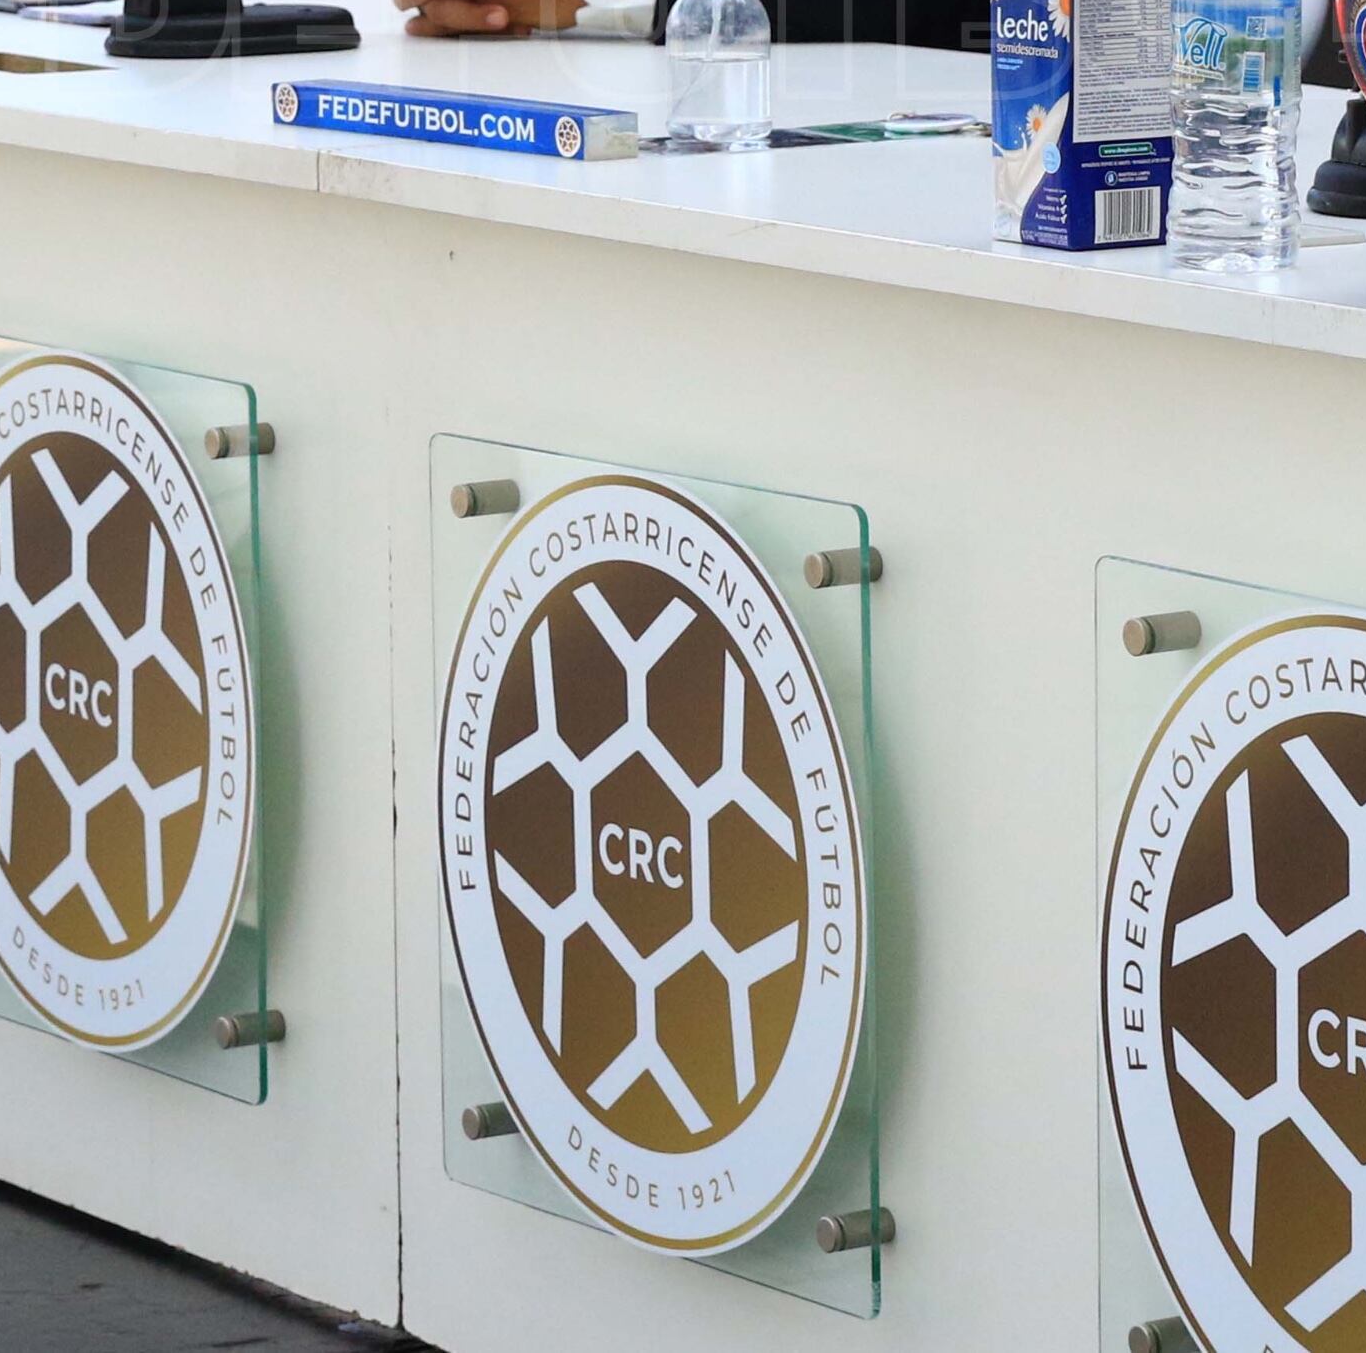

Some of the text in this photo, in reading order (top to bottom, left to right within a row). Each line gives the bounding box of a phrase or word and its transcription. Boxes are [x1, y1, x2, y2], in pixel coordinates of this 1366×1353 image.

[996, 6, 1049, 42] leche
[318, 94, 536, 143] FEDEFUTBOL.COM
[44, 662, 113, 729] CRC
[189, 546, 216, 611] DE
[210, 632, 237, 826] FÚTBOL
[453, 511, 843, 987] FEDERACIÓN COSTARRICENSE DE FÚTBOL
[597, 821, 684, 889] CRC
[1122, 721, 1217, 1071] FEDERACIÓN
[11, 925, 145, 1012] DESDE 1921
[566, 1124, 738, 1212] DESDE 1921
